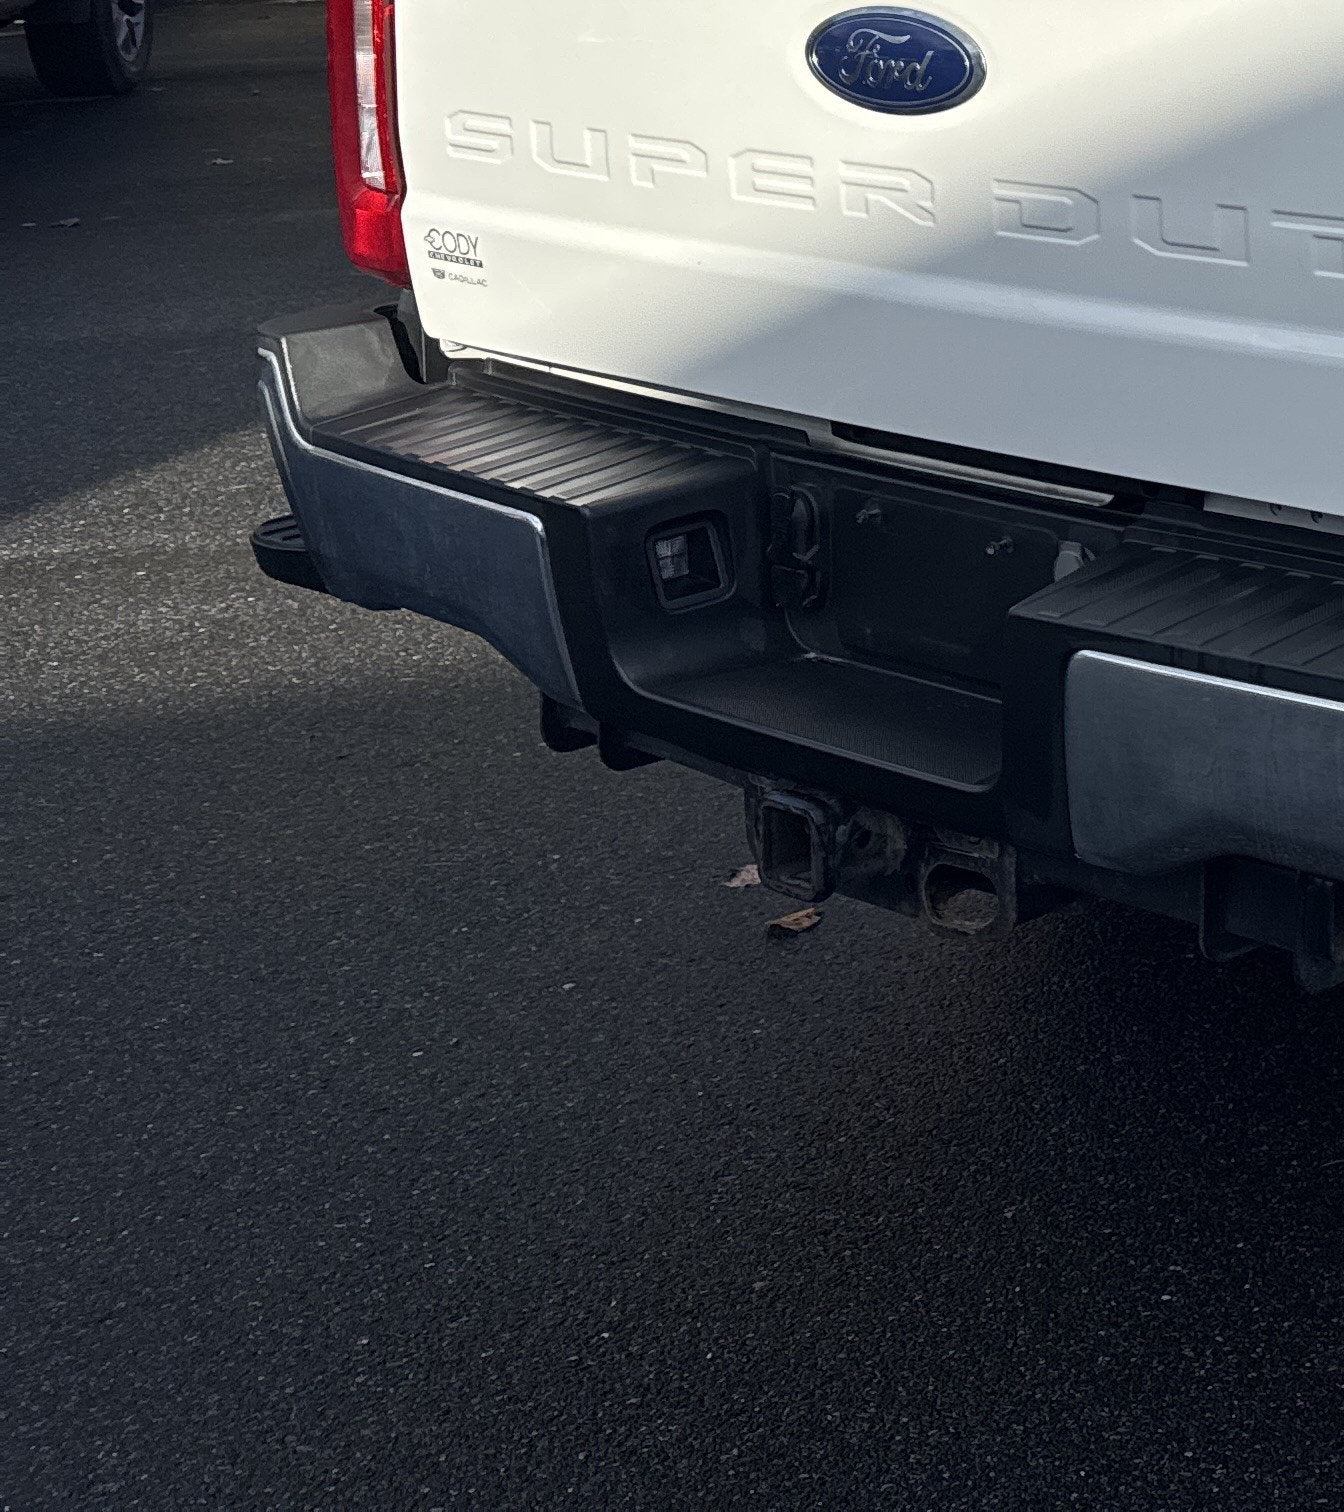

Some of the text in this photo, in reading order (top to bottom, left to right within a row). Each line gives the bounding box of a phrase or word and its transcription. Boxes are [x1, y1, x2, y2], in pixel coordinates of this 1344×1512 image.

[838, 28, 935, 92] Ford
[444, 108, 937, 227] SUPER
[424, 228, 479, 257] CODY
